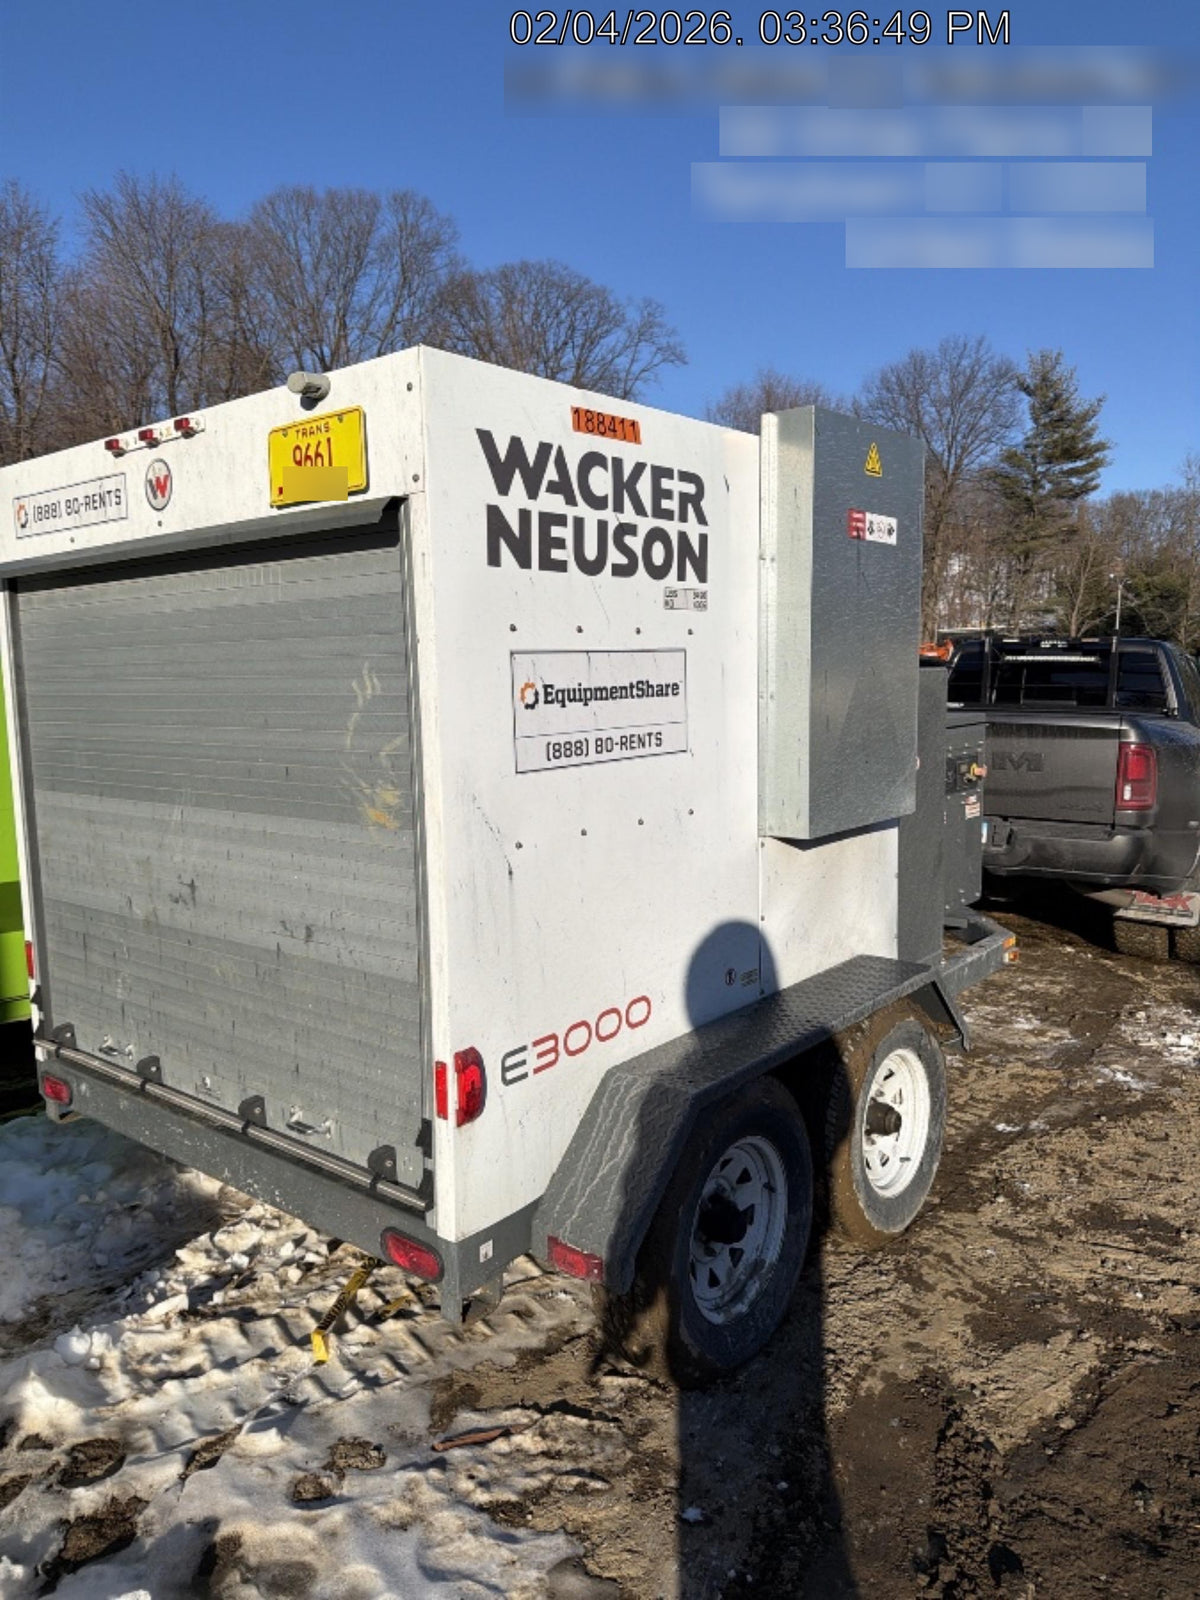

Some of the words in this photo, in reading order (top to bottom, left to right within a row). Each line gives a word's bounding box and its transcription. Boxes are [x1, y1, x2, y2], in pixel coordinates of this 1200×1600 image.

[295, 421, 330, 440] TRANS
[573, 408, 638, 443] 188411
[475, 427, 709, 526] WACKER
[33, 501, 62, 523] (888)
[486, 503, 709, 584] NEUSON
[543, 680, 681, 708] EquipmentShare
[546, 738, 589, 761] (888)
[501, 995, 651, 1086] E3000
